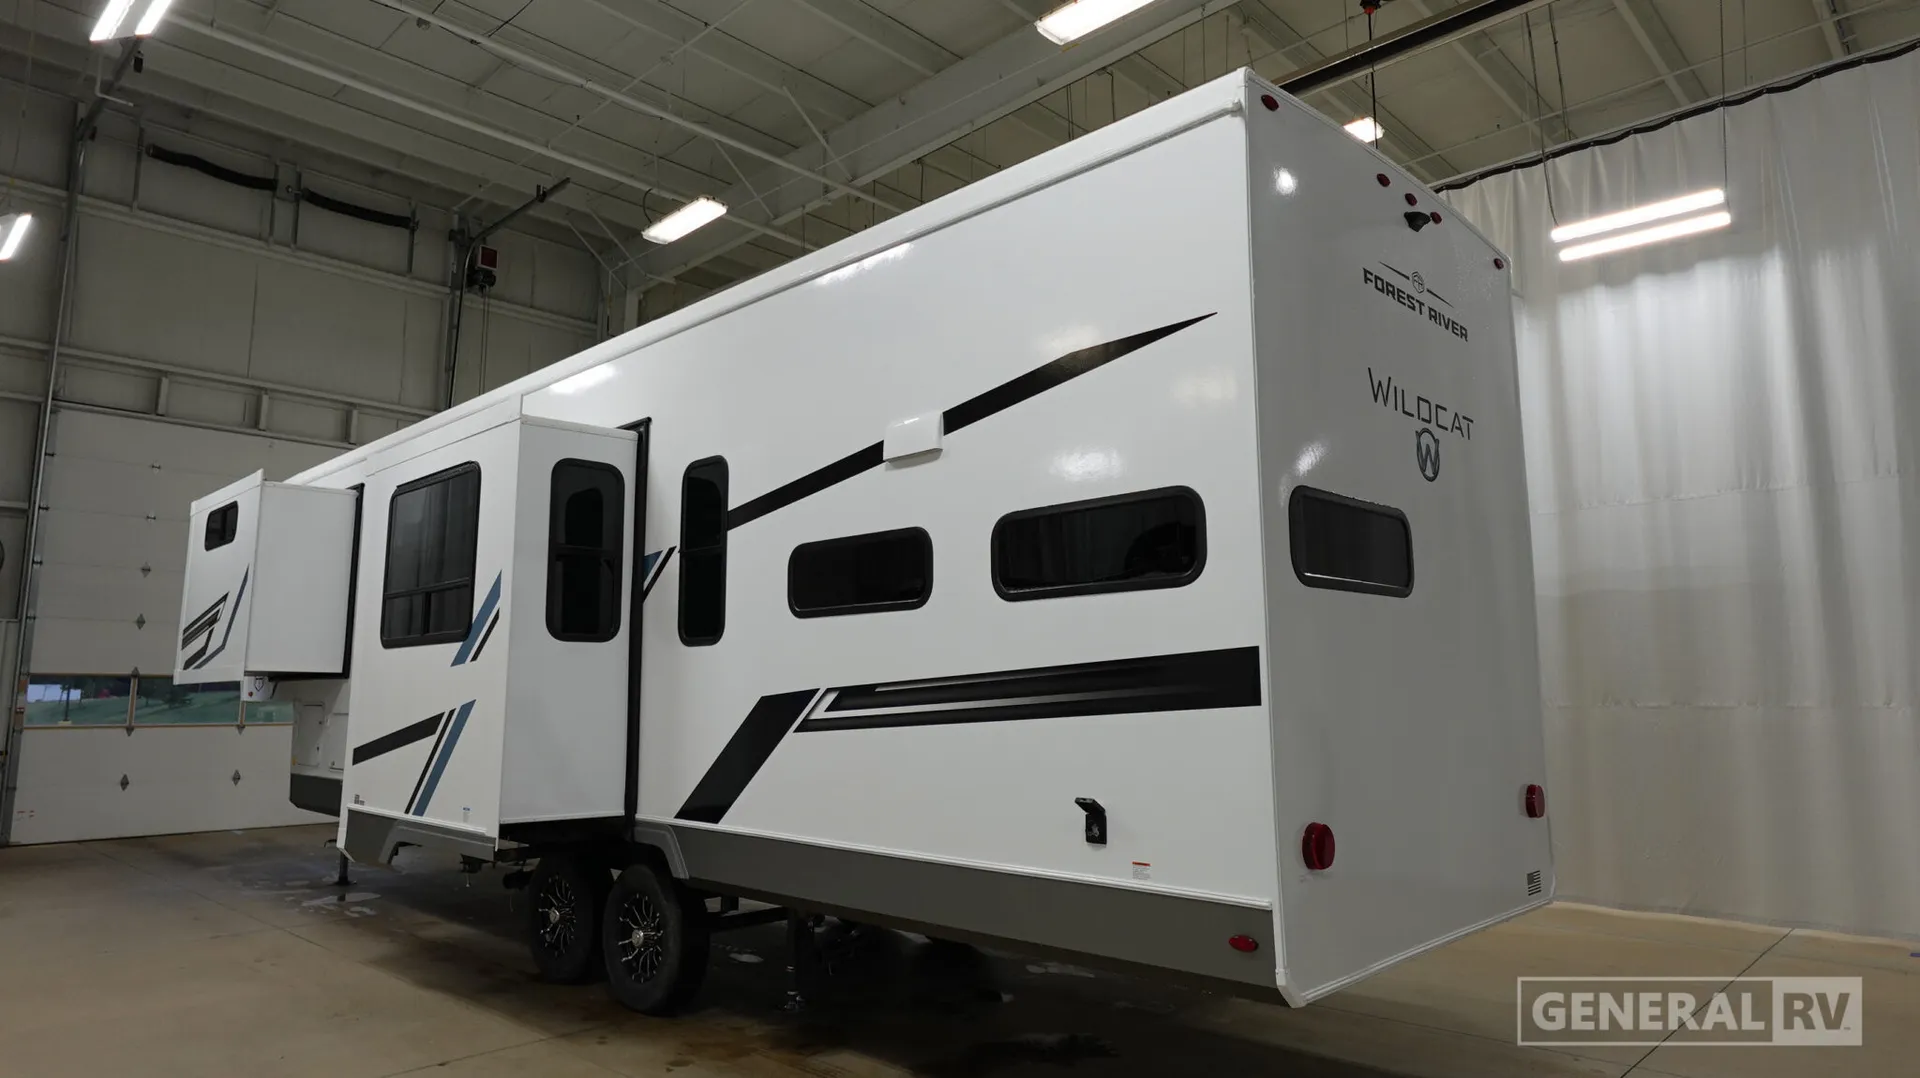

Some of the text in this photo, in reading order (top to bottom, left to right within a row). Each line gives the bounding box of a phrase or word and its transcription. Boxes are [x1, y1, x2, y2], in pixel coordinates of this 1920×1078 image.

[1363, 267, 1469, 342] FOREST RIVER
[1368, 367, 1474, 440] WILDCAT
